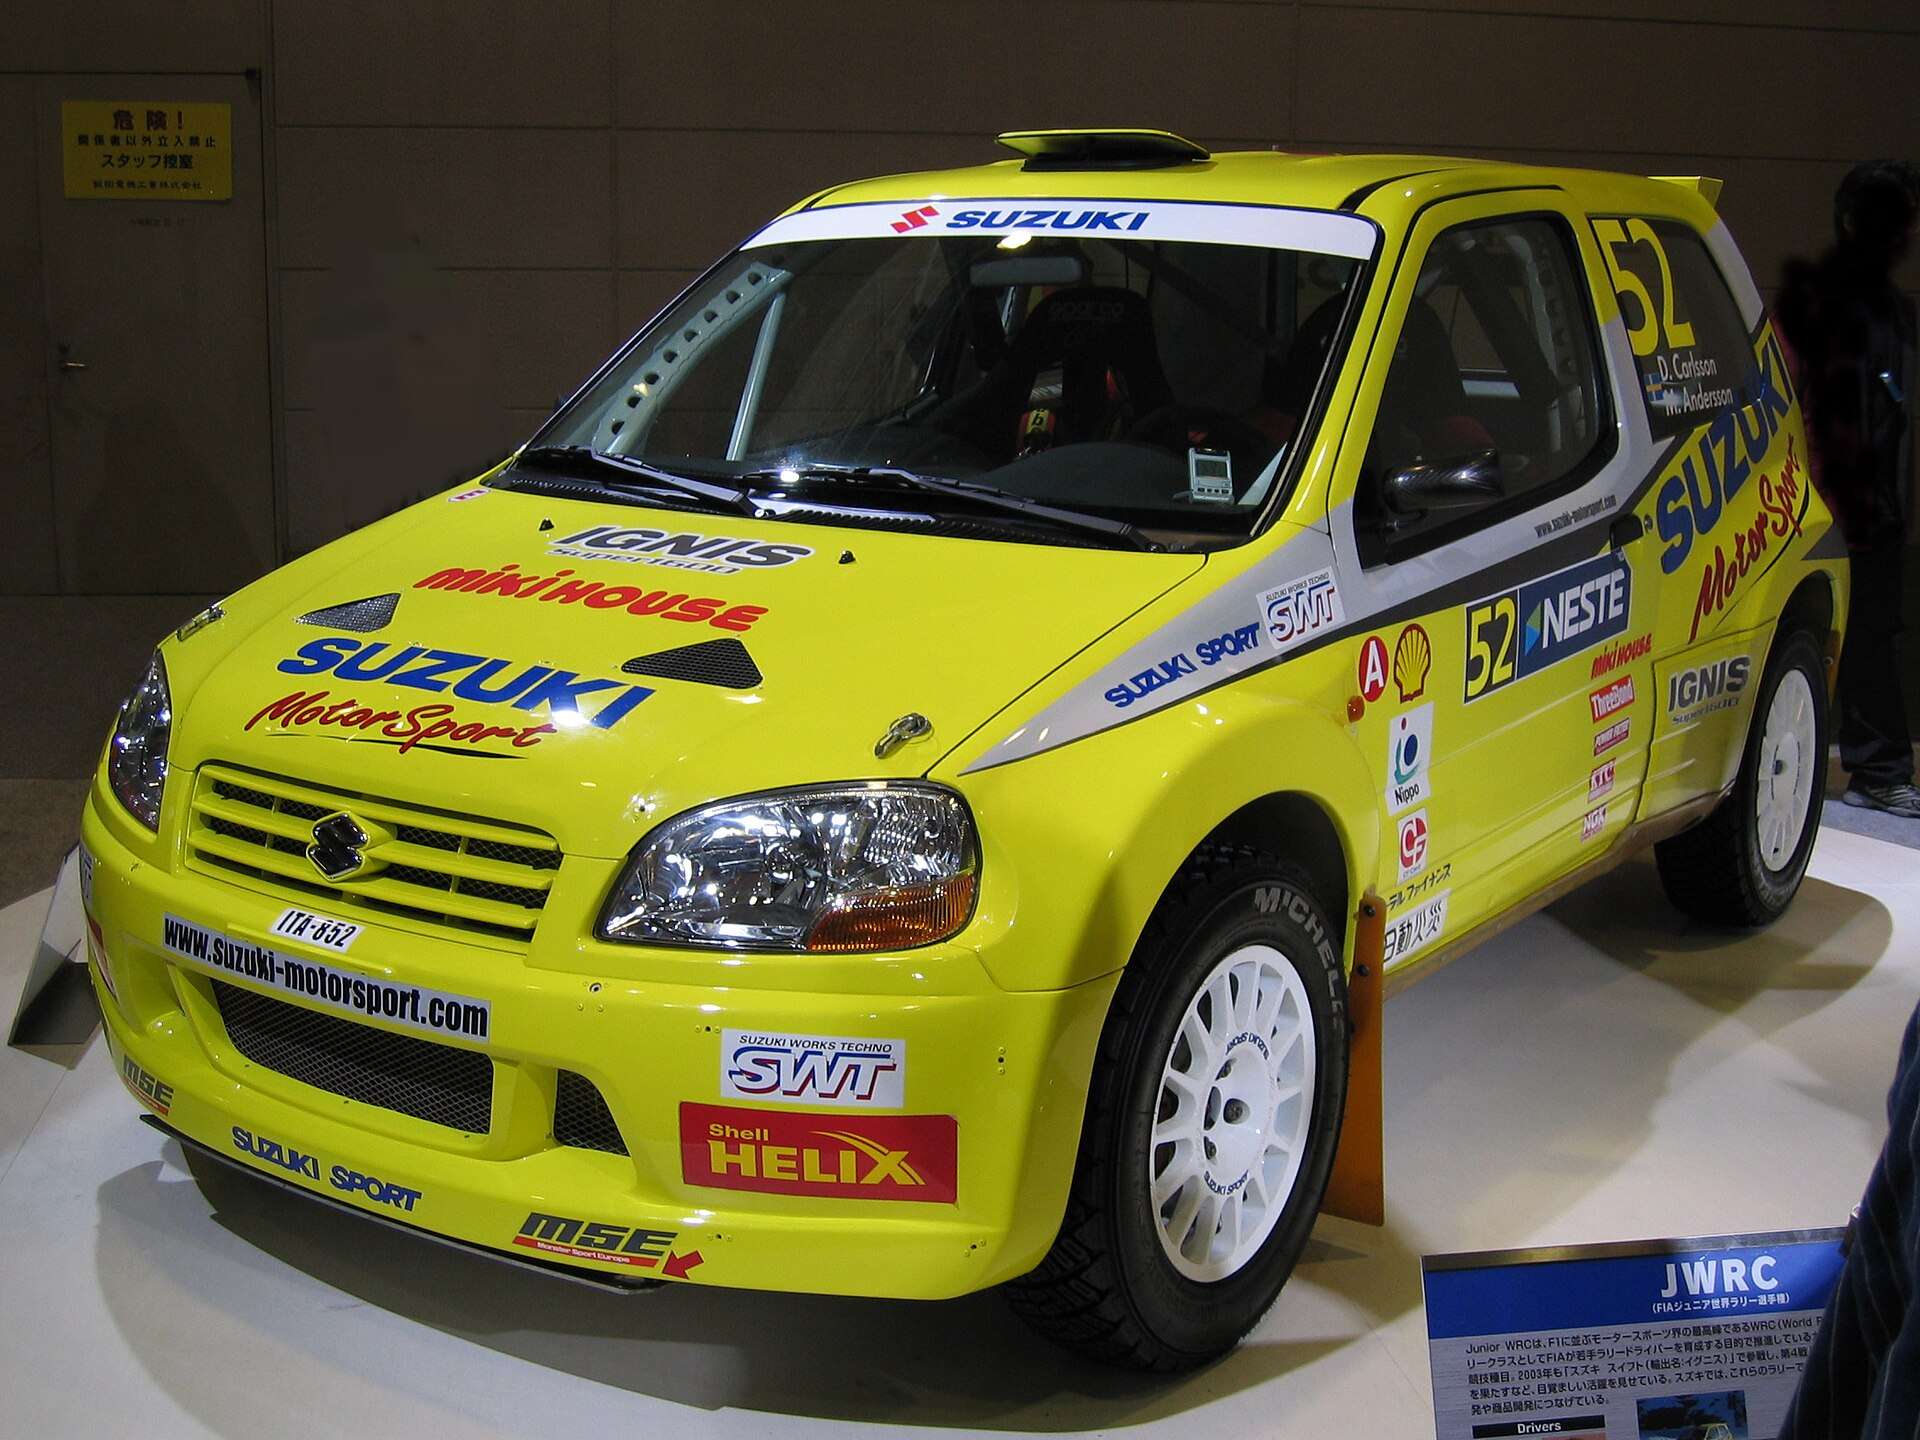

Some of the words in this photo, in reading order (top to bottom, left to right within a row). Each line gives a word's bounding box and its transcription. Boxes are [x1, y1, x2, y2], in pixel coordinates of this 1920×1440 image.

[102, 154, 193, 169] スタッフ控室
[946, 210, 1151, 232] SUZUKI
[1591, 217, 1696, 356] 52
[1656, 355, 1673, 381] D.
[1673, 351, 1717, 379] Carlsson
[1683, 384, 1733, 413] Andersson
[1657, 331, 1795, 575] SUZUKI
[546, 548, 742, 575] Super1600
[554, 526, 813, 567] IGNIS
[1688, 433, 1801, 646] MotorSport
[1267, 580, 1336, 643] SWT
[1466, 597, 1517, 698] 52
[1542, 569, 1625, 649] NESTE
[277, 637, 657, 729] SUZUKI
[1104, 653, 1198, 708] SUZUKI
[1196, 622, 1260, 666] SPORT
[1668, 656, 1751, 712] IGNIS
[244, 691, 558, 754] MotorSport
[1395, 783, 1420, 806] Nippo
[277, 910, 357, 948] ITA-852
[1384, 900, 1442, 964] 日動火災
[164, 918, 489, 1037] www.suzuki-motorsport.com
[740, 1035, 786, 1048] SUZUKI
[790, 1039, 838, 1051] WORKS
[841, 1042, 893, 1053] TECHNO
[728, 1046, 897, 1100] SWT
[709, 1123, 769, 1142] Shell
[231, 1126, 320, 1181] SUZUKI
[329, 1165, 422, 1212] SPORT
[708, 1134, 927, 1186] HELIX
[1661, 1256, 1779, 1298] JWRC
[1466, 1343, 1501, 1354] Junior
[1517, 1421, 1562, 1434] Drivers
